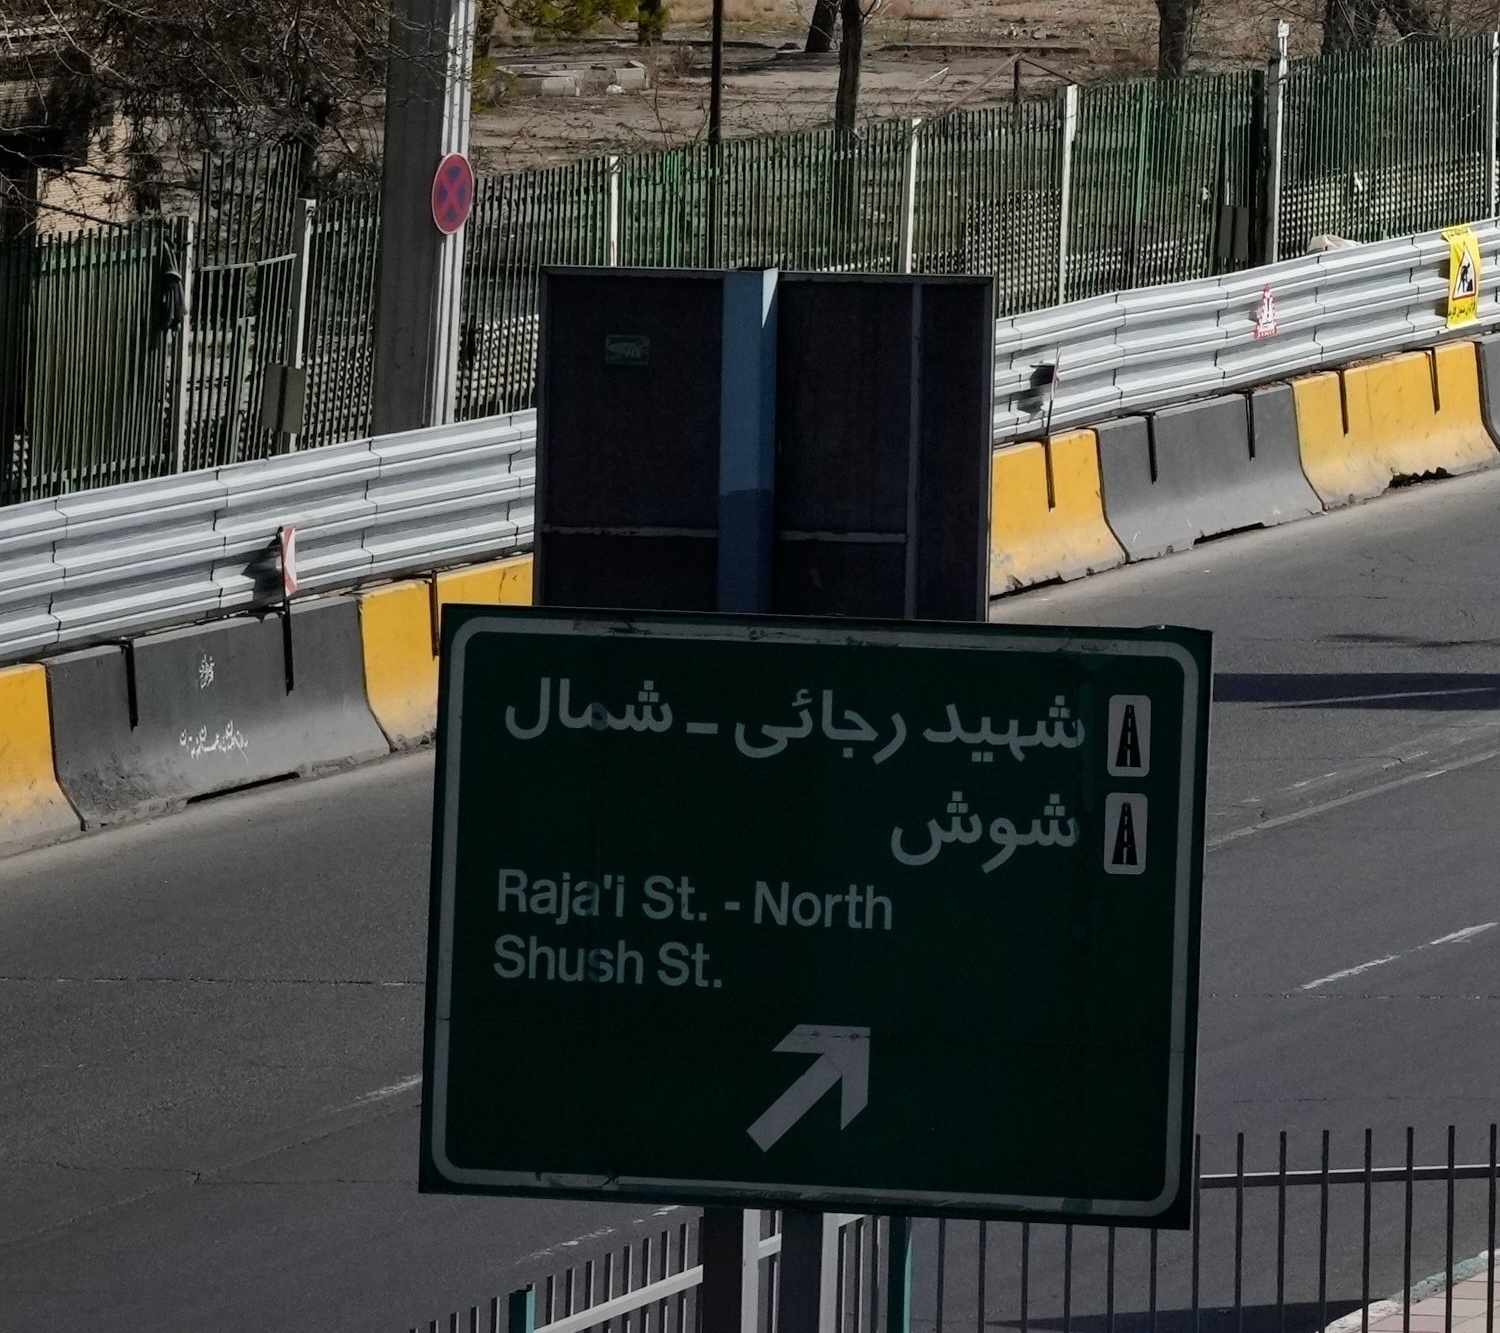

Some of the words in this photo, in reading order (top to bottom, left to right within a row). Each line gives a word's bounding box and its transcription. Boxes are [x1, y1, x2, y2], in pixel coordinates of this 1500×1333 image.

[505, 677, 672, 739] شمال
[923, 696, 1085, 762] شهید
[891, 791, 1076, 873] شوش
[498, 869, 624, 925] Raja'i
[642, 876, 707, 921] St.
[754, 881, 892, 930] North
[494, 934, 643, 984] Shush
[658, 942, 722, 987] St.
